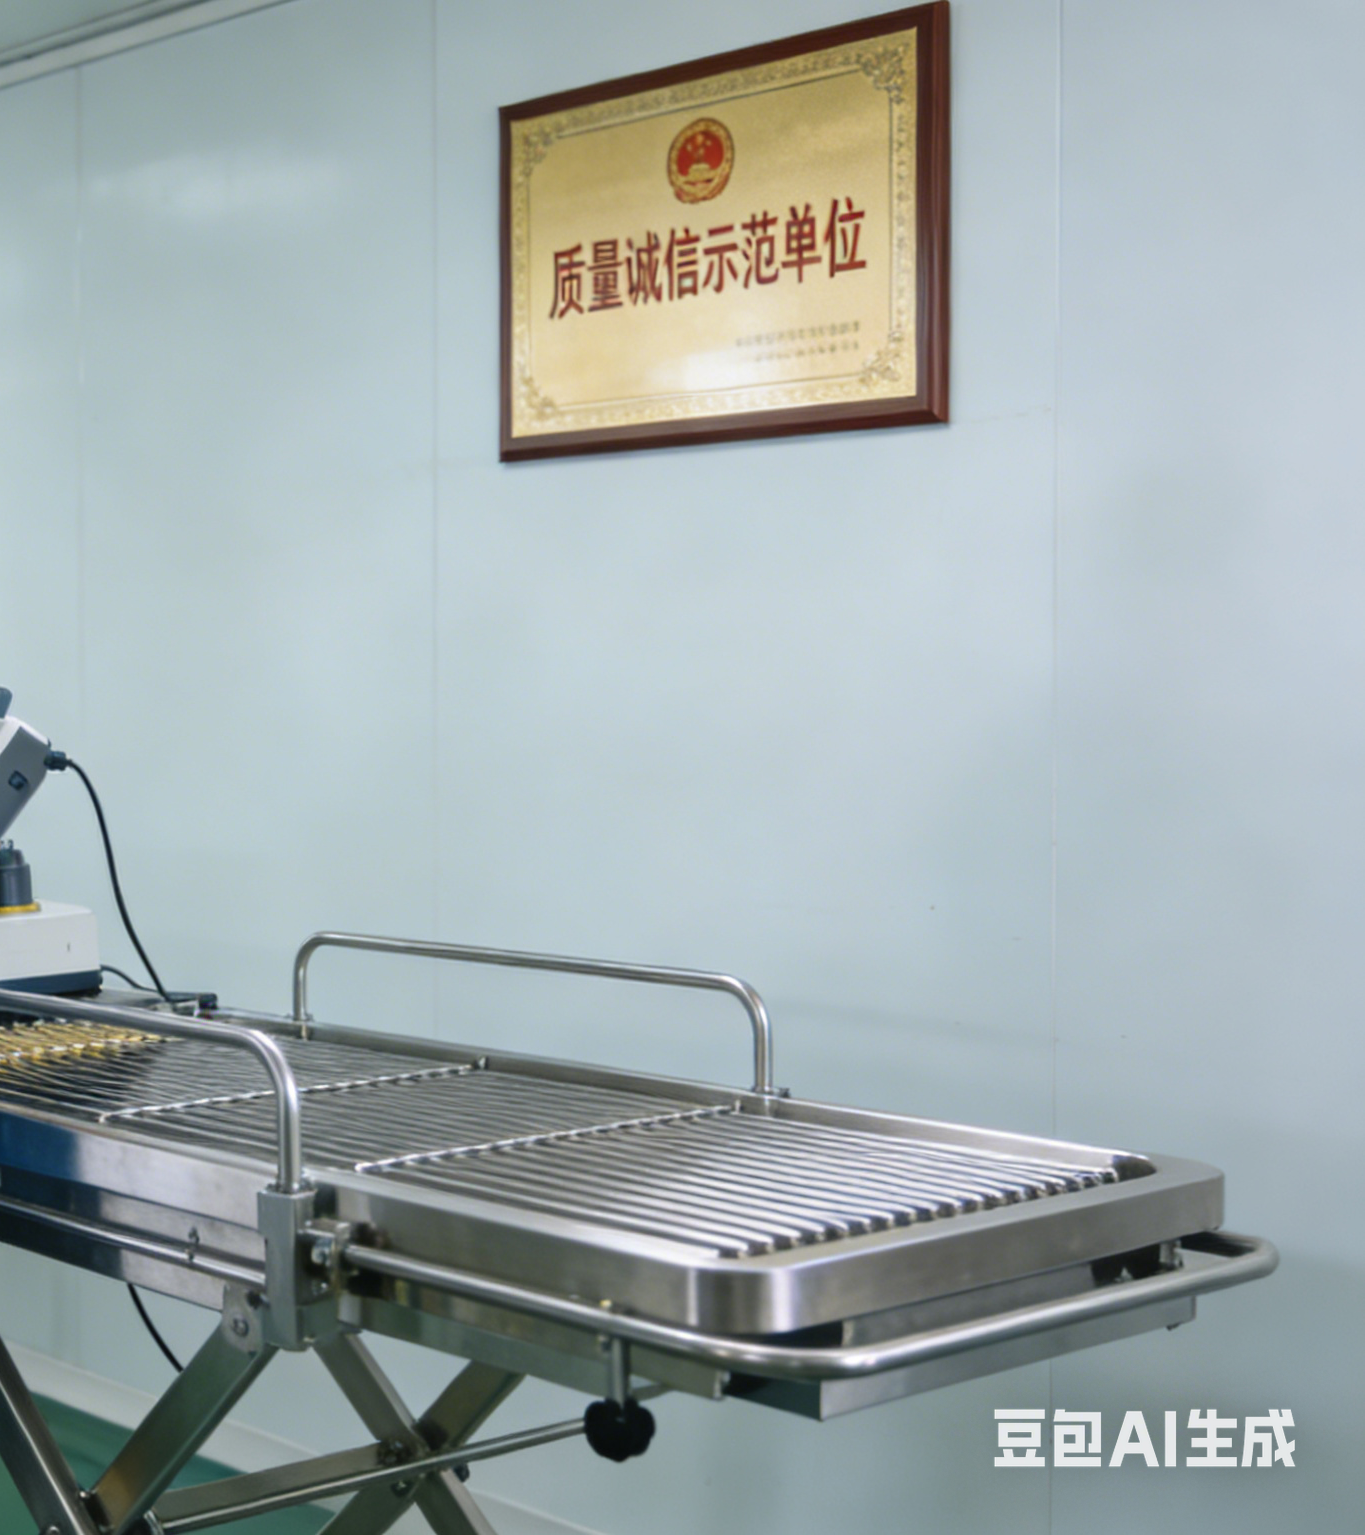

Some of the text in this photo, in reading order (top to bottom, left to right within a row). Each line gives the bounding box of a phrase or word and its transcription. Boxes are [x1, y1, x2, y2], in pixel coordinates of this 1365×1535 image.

[549, 197, 867, 320] 质量诚信示范单位
